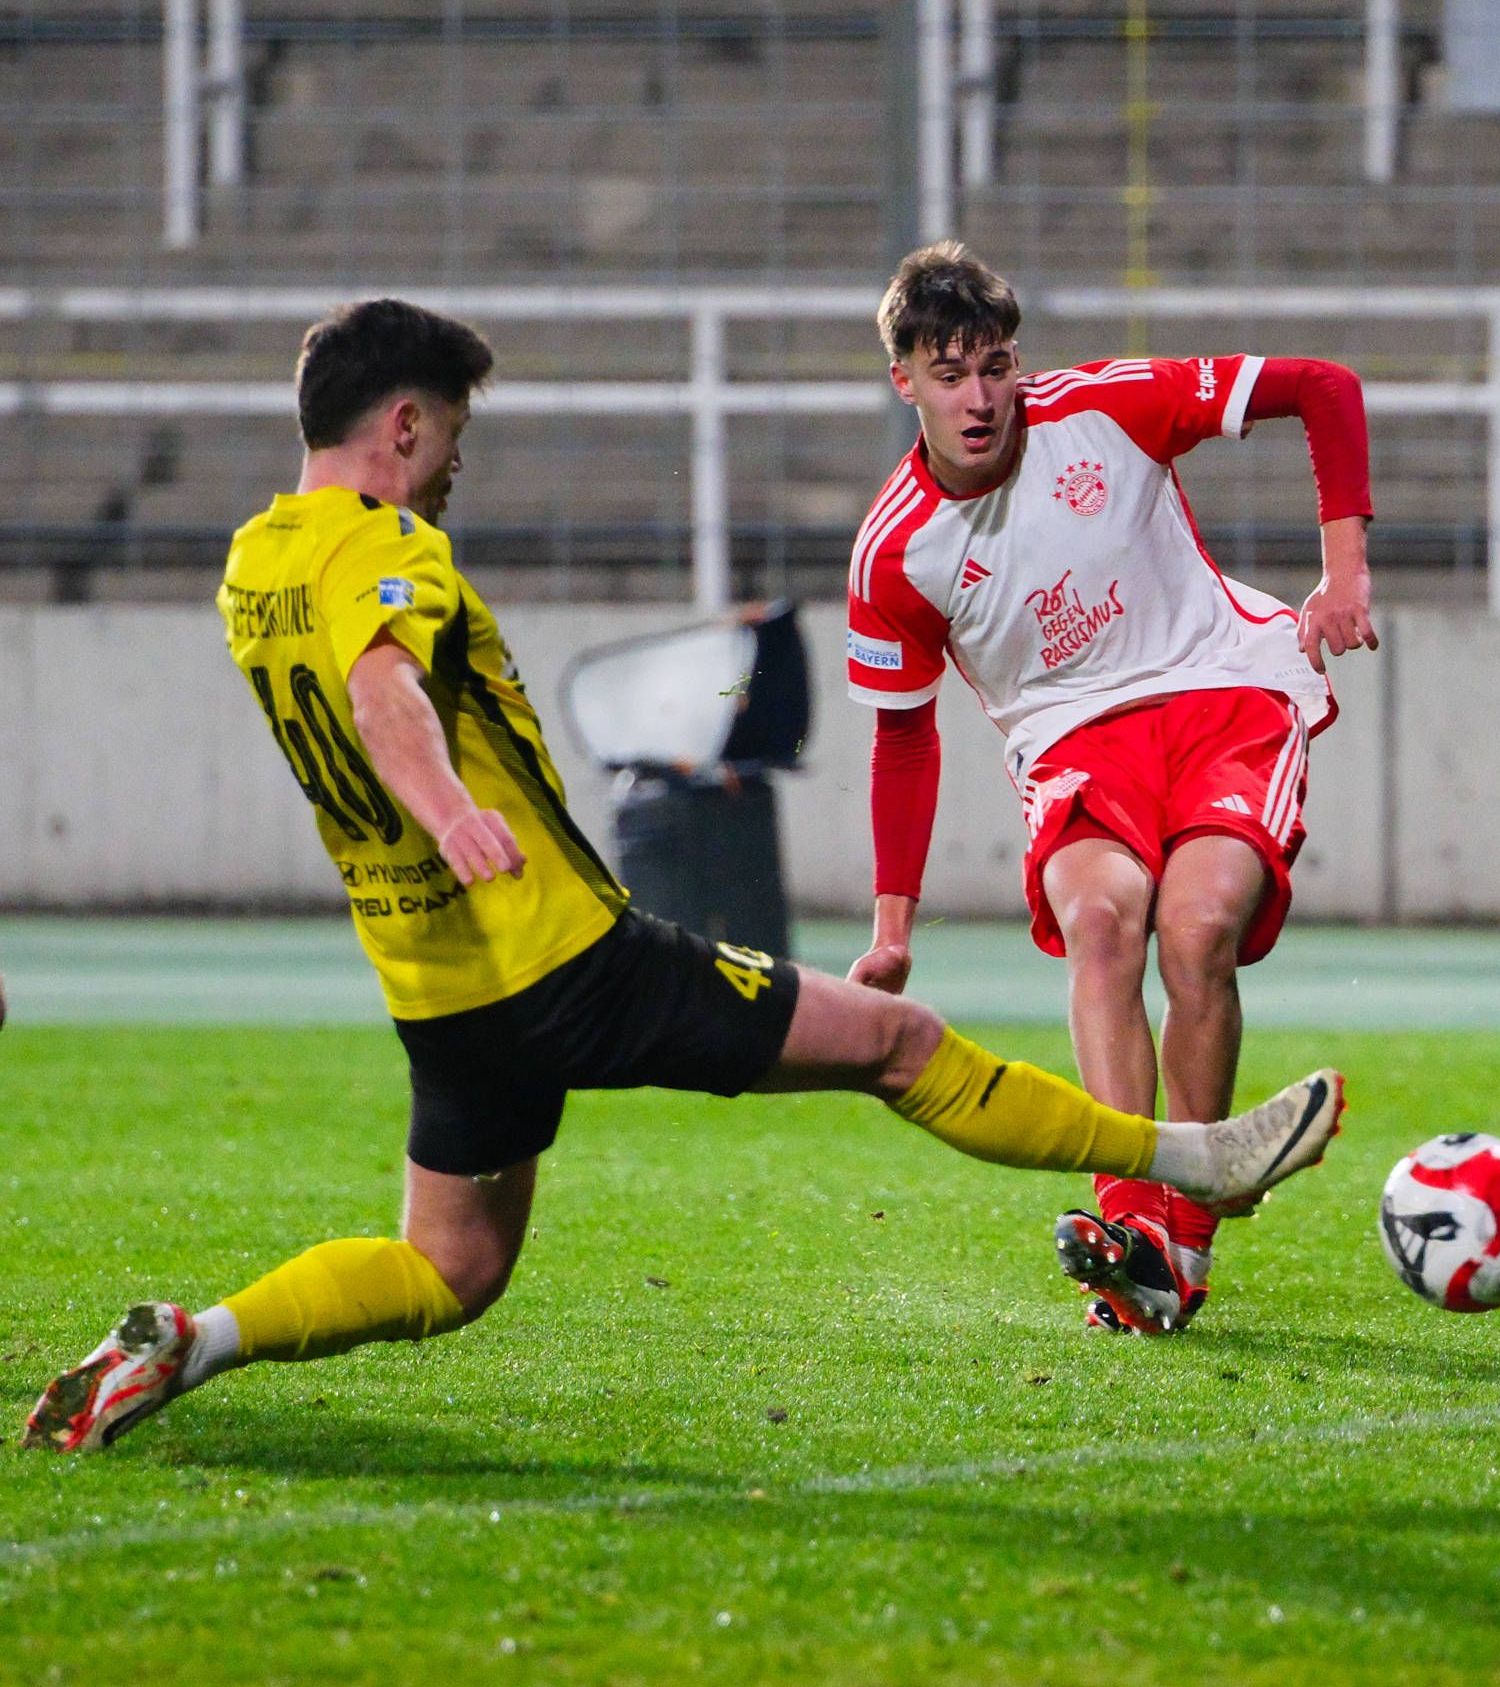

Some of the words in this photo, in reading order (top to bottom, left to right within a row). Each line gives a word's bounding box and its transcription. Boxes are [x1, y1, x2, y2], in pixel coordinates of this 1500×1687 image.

[1024, 569, 1072, 624] ROT
[1040, 579, 1124, 669] RASSISMUS
[1042, 588, 1086, 641] GEGEN
[855, 648, 899, 667] BAYERN
[250, 662, 404, 846] 40
[713, 941, 775, 1001] 40
